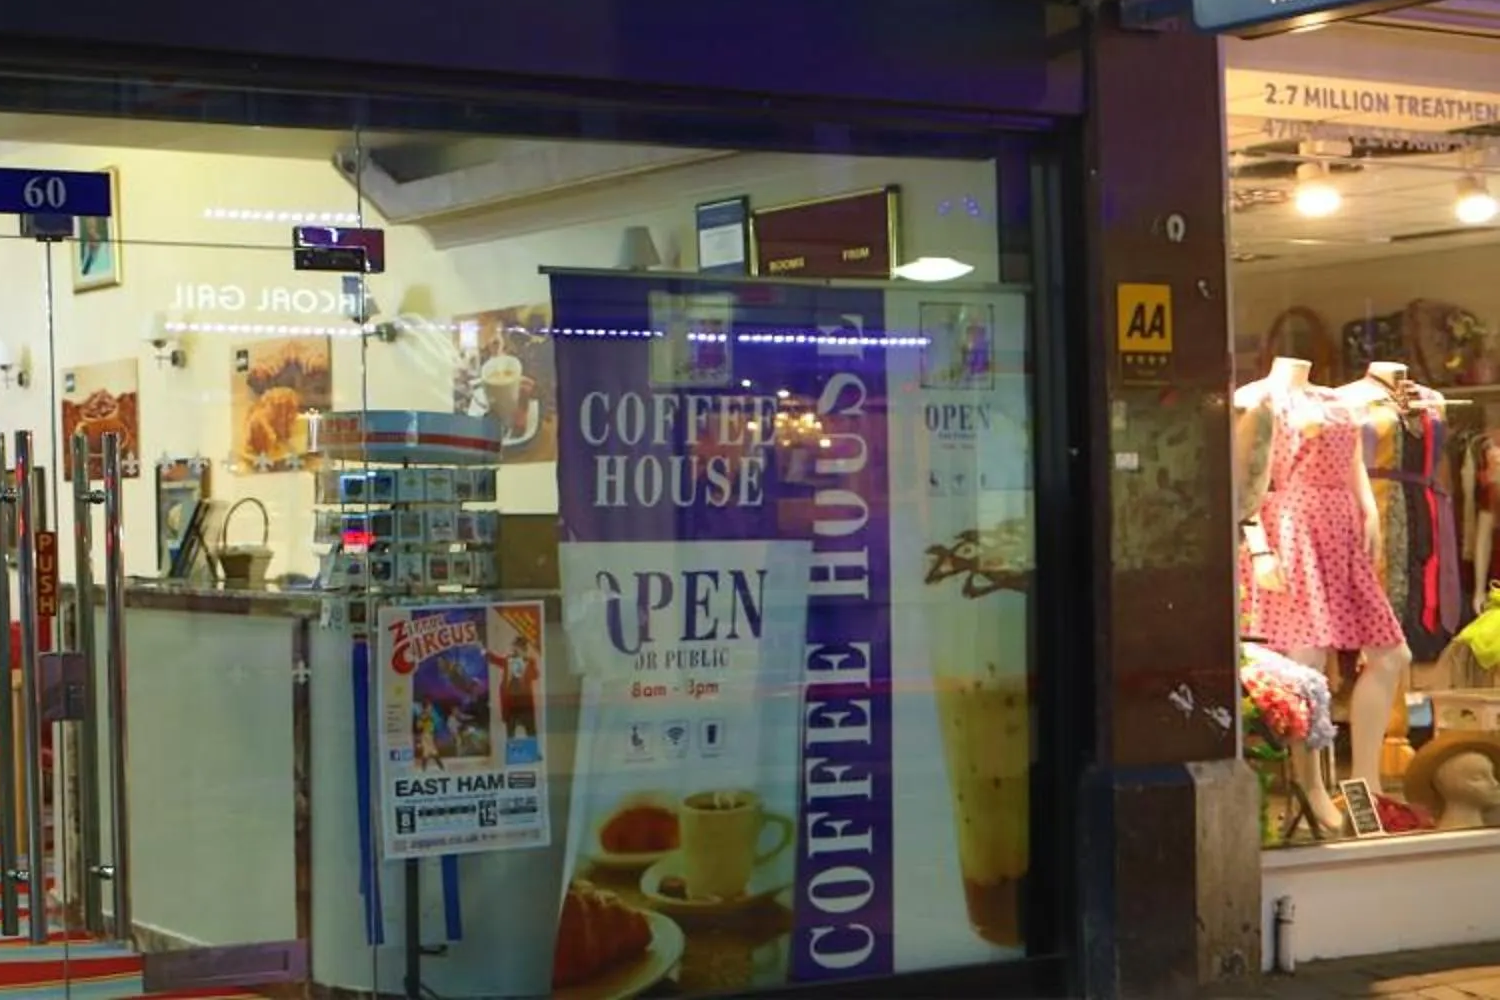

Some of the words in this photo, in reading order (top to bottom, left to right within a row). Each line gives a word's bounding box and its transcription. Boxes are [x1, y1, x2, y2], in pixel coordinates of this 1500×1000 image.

[1264, 83, 1299, 106] 2.7
[1303, 87, 1389, 114] MILLION
[23, 176, 67, 209] 60
[1126, 301, 1166, 340] AA
[579, 390, 777, 447] COFFEE
[925, 403, 992, 432] OPEN
[594, 453, 765, 508] HOUSE
[806, 311, 871, 601] HOUSE
[38, 533, 55, 614] PUSH
[595, 568, 769, 656] OPEN
[391, 621, 477, 674] CIRCUS
[664, 647, 731, 671] PUBLIC
[394, 777, 451, 797] EAST
[456, 773, 504, 793] HAM
[805, 639, 875, 970] COFFEE
